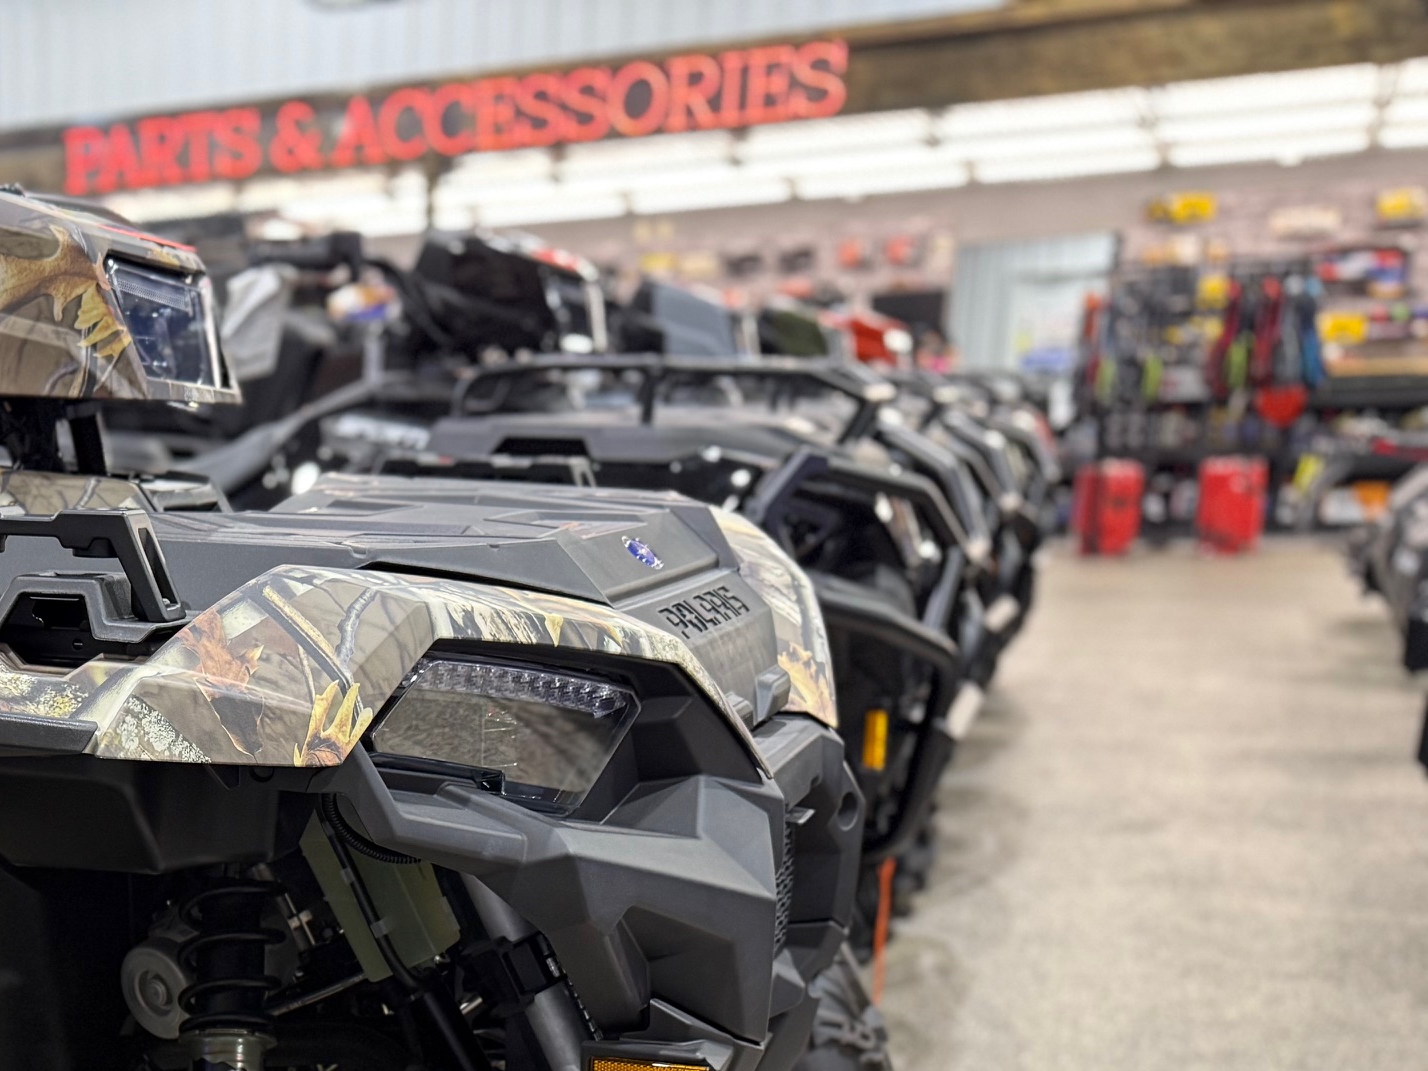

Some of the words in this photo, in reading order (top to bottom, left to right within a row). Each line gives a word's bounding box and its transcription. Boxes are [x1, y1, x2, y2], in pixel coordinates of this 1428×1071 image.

[63, 106, 264, 196] PARTS
[269, 100, 324, 173] &
[331, 40, 849, 169] ACCESSORIES
[658, 585, 751, 640] POLARIS
